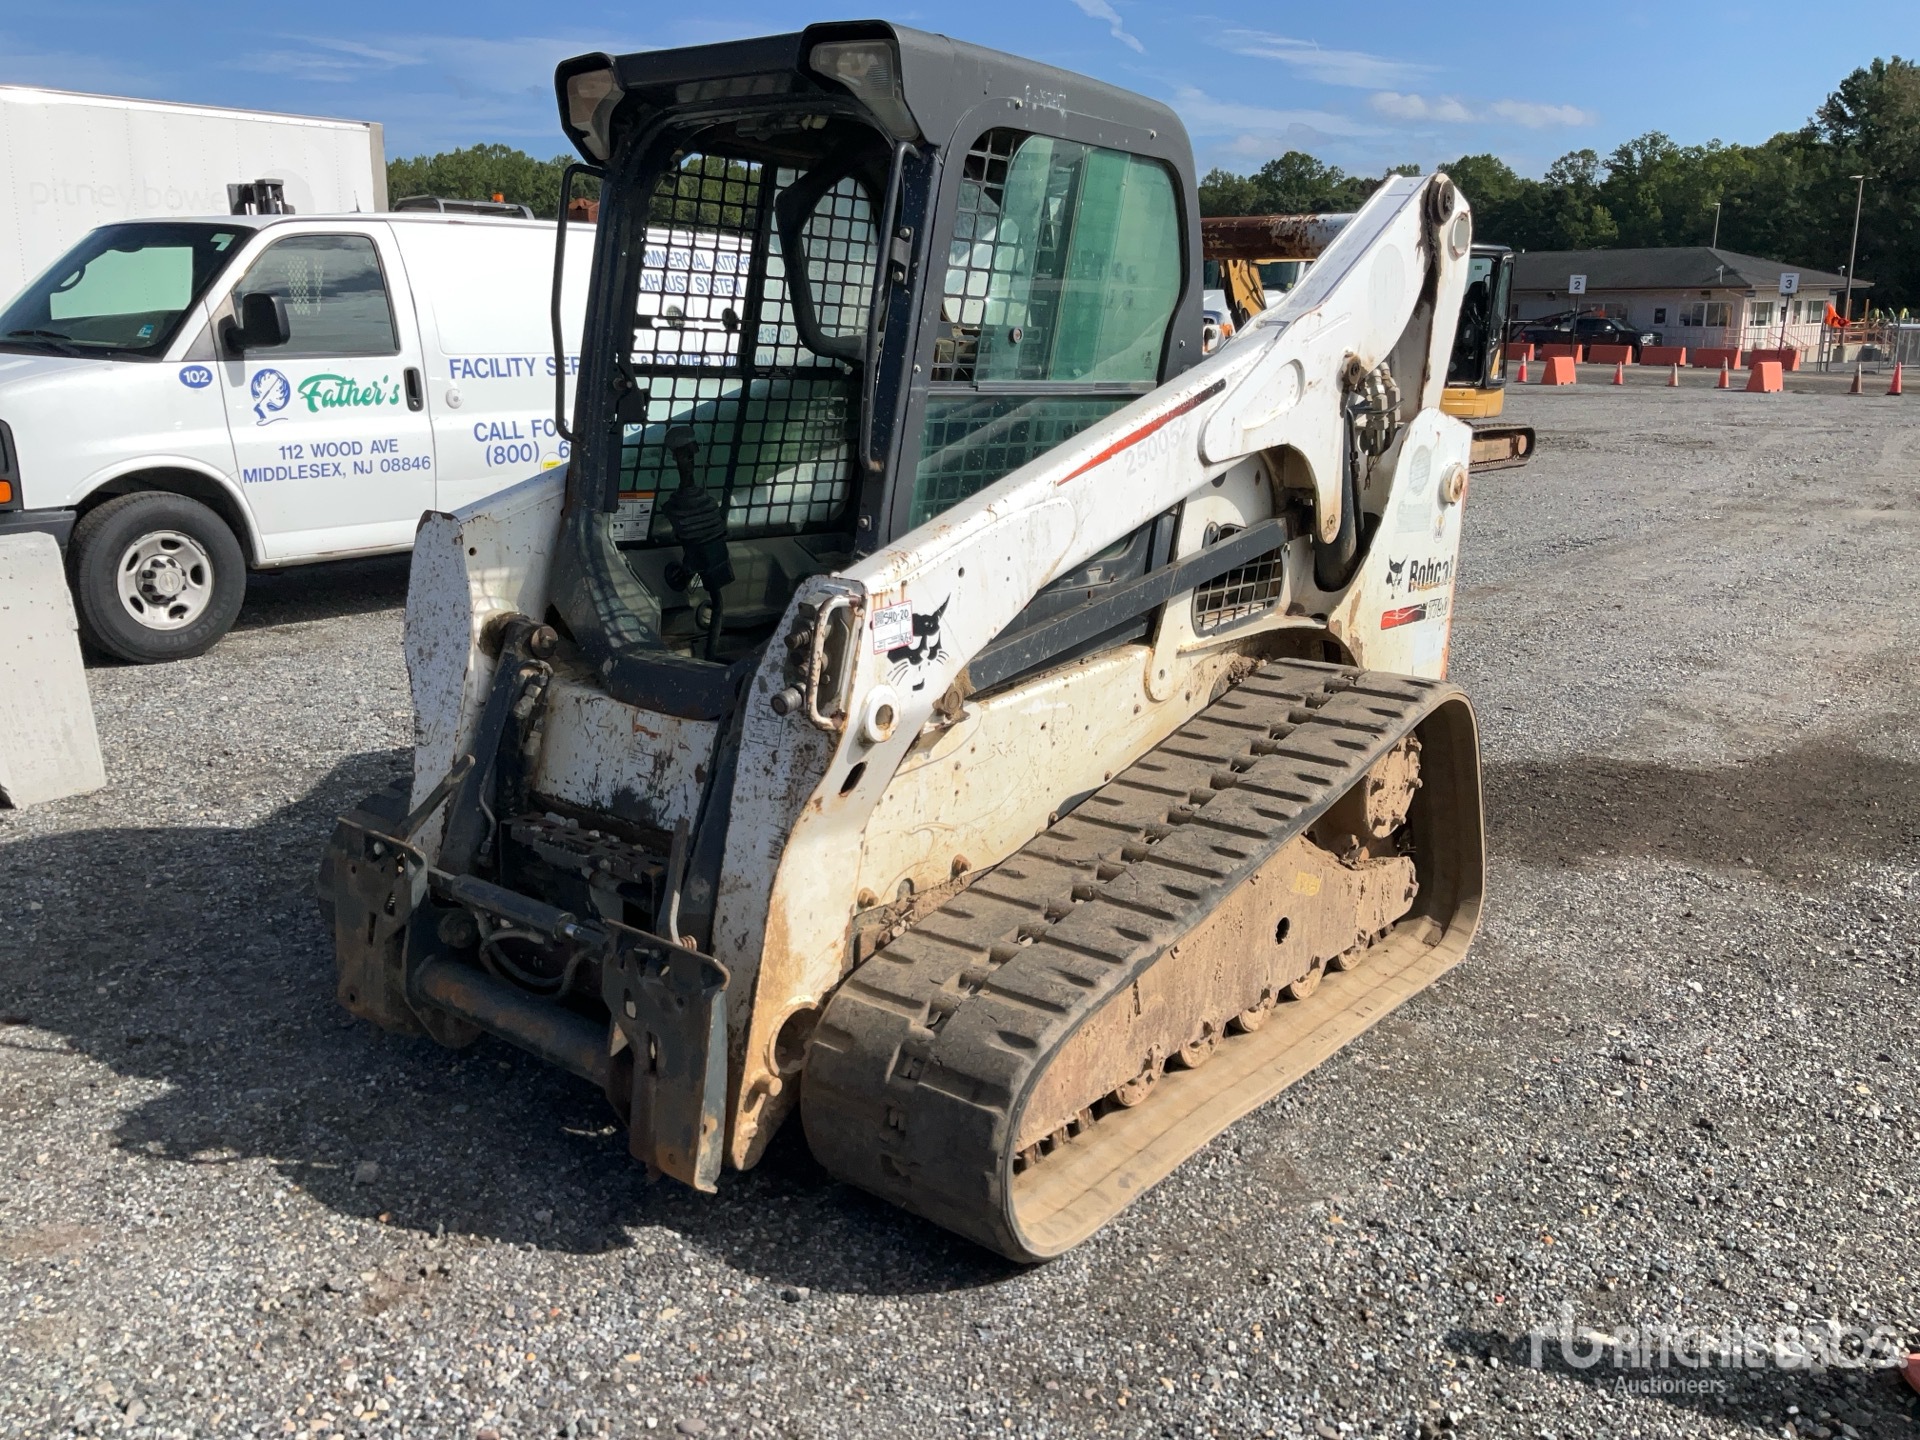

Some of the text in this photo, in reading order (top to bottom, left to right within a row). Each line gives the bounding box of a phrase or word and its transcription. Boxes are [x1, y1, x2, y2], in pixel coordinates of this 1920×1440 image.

[143, 176, 227, 213] bowe
[641, 272, 688, 293] XHAUST
[1574, 280, 1581, 290] 2
[1785, 279, 1793, 289] 3
[182, 370, 210, 383] 102
[449, 357, 536, 379] FACILITY
[297, 373, 400, 413] Father's
[473, 421, 524, 443] CALL
[278, 438, 399, 460] 112 WOOD AVE
[486, 441, 540, 468] (800)
[243, 456, 431, 483] MIDDLESEX, NJ 08846
